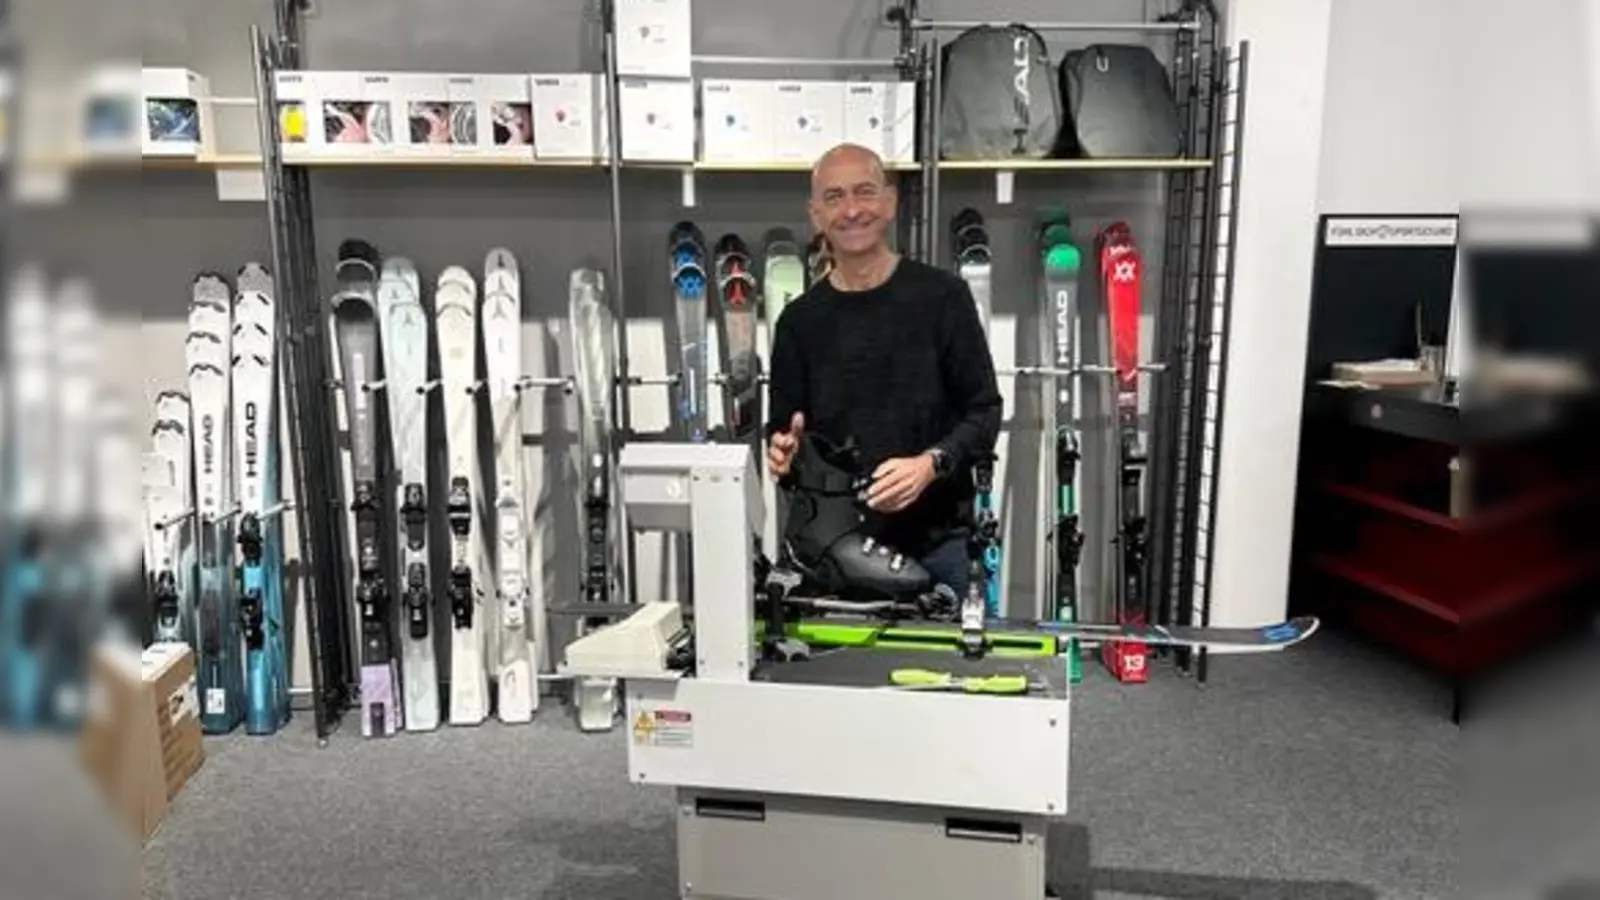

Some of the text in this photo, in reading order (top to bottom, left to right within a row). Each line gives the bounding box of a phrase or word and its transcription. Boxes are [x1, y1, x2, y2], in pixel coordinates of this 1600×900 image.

[1057, 289, 1070, 363] HEAD
[202, 413, 214, 475] HEAD
[245, 400, 258, 478] HEAD
